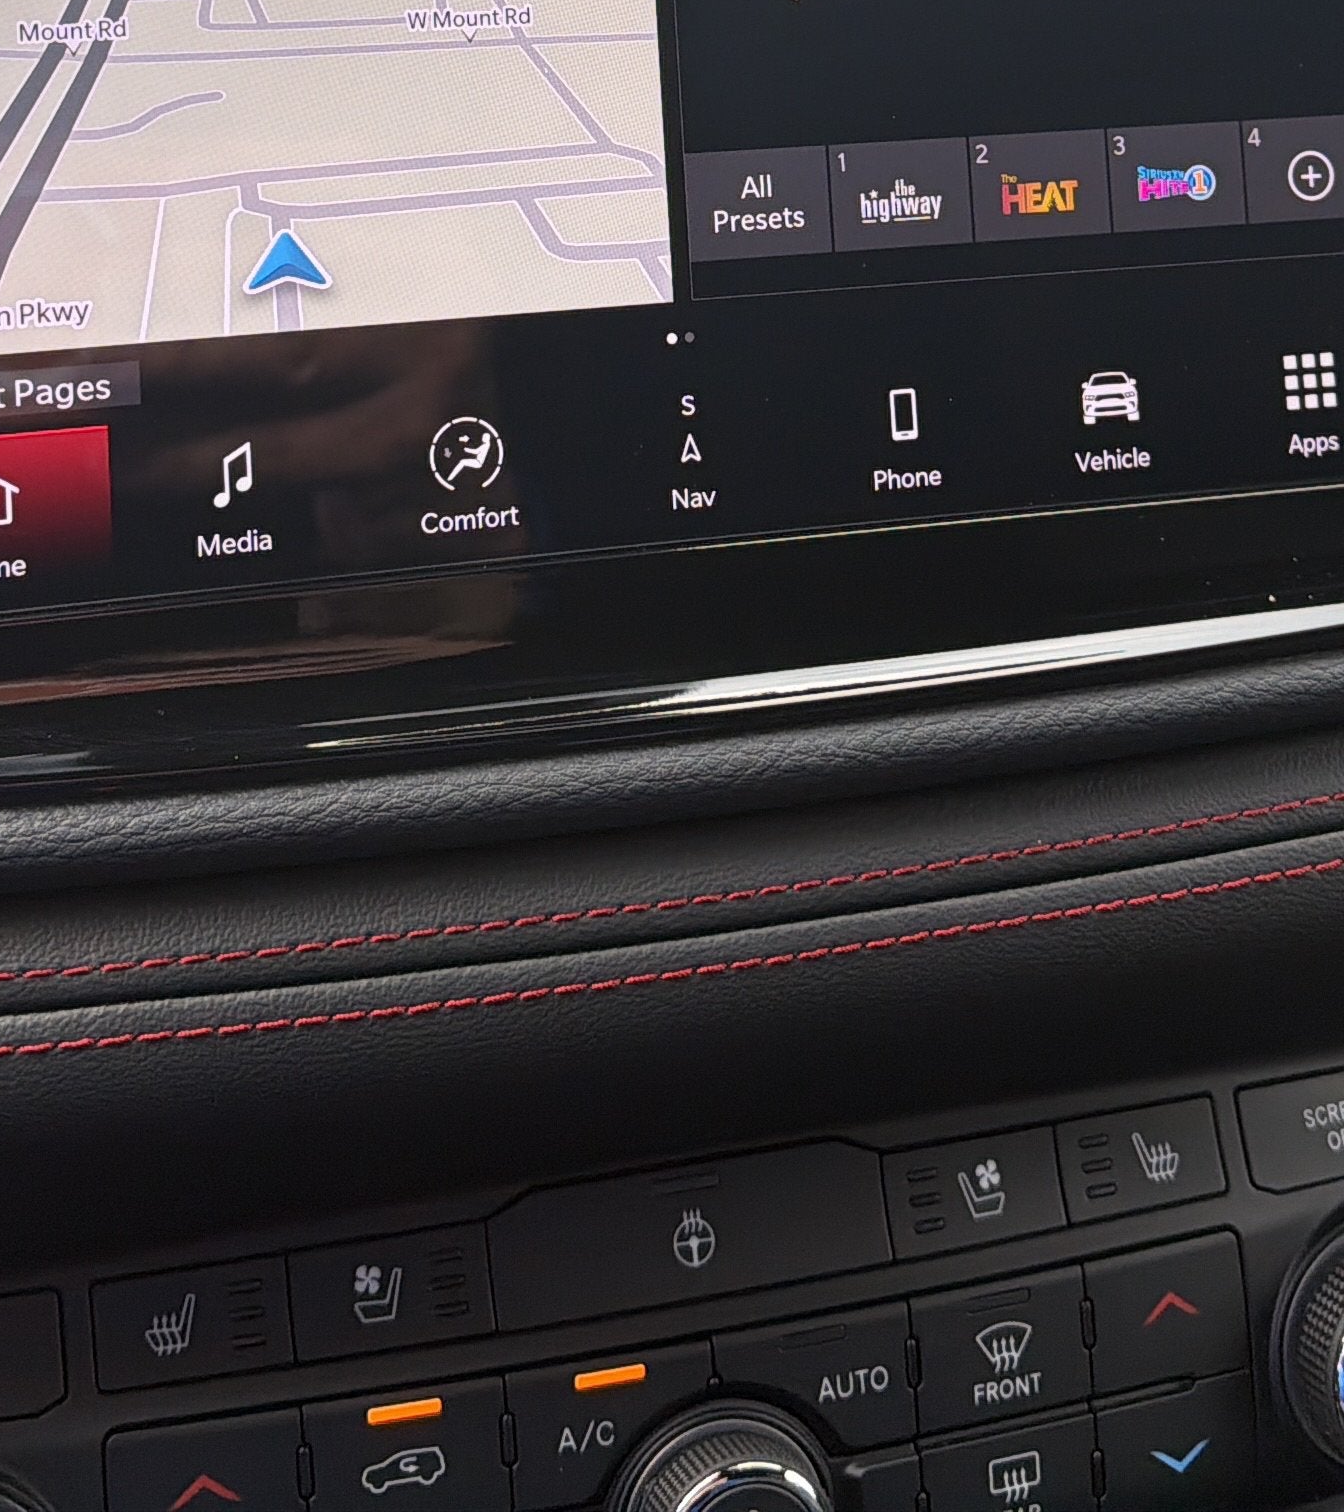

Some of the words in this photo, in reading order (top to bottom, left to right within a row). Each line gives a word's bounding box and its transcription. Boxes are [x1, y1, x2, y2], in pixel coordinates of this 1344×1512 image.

[407, 12, 429, 29] W
[433, 10, 499, 29] Mount
[505, 7, 531, 26] Rd
[19, 23, 90, 42] Mount
[98, 20, 126, 39] Rd
[1112, 135, 1126, 156] 3
[1247, 127, 1262, 147] 4
[837, 152, 846, 173] 1
[975, 143, 989, 164] 2
[740, 173, 773, 200] All
[895, 179, 916, 197] the
[1001, 180, 1078, 215] HEAT
[860, 190, 942, 223] highway
[713, 207, 805, 234] Presets
[19, 302, 89, 326] Pkwy
[14, 378, 111, 410] Pages
[681, 394, 696, 416] S
[1288, 433, 1340, 458] Apps
[1074, 446, 1151, 473] Vehicle
[873, 468, 942, 492] Phone
[671, 487, 717, 511] Nav
[420, 505, 520, 534] Comfort
[197, 528, 273, 558] Media
[818, 1365, 889, 1403] AUTO
[973, 1367, 1042, 1405] FRONT
[558, 1420, 615, 1454] A/C
